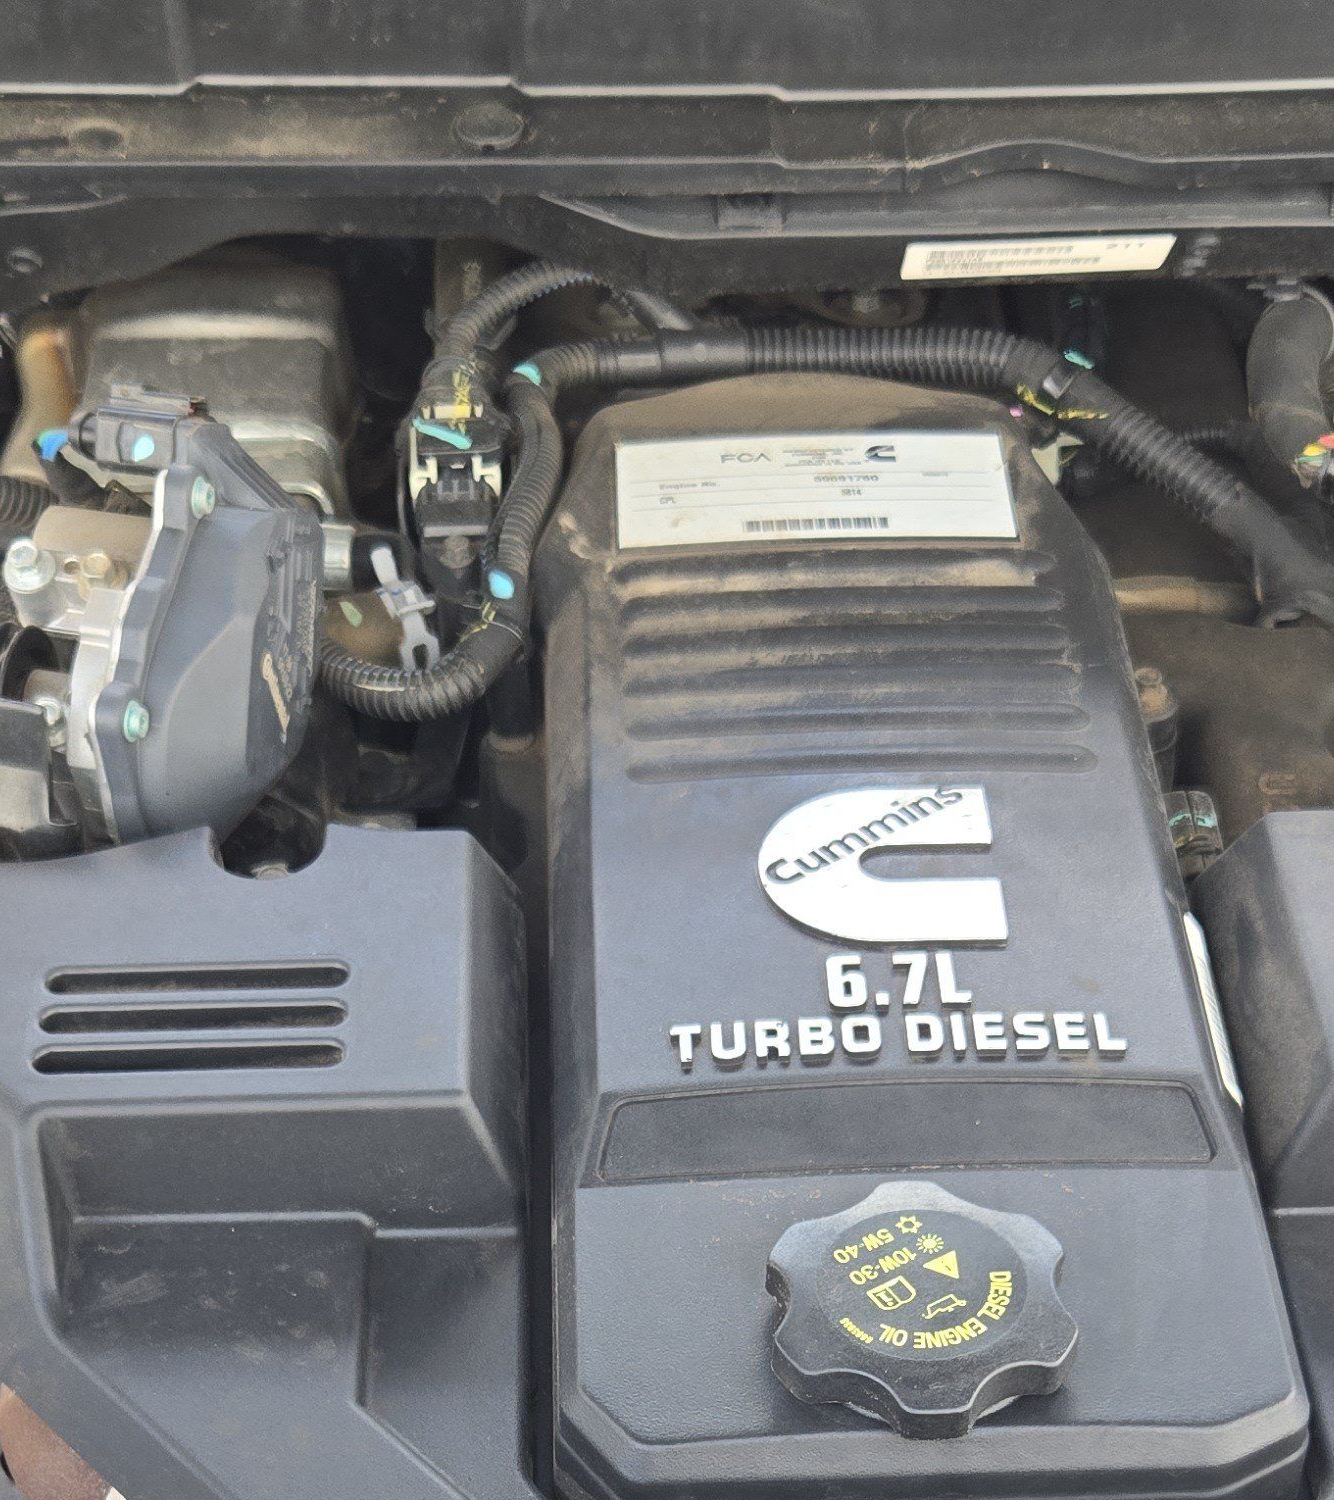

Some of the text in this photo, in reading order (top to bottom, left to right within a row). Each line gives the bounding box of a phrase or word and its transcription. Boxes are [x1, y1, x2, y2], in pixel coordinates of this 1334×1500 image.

[720, 452, 772, 463] FCA
[766, 785, 964, 885] Cummins
[824, 951, 972, 1009] 6.7L
[670, 1012, 1129, 1068] TURBO DIESEL
[833, 1228, 894, 1264] 5W-40
[848, 1247, 917, 1285] 10W-30
[977, 1270, 1013, 1320] DIESEL
[879, 1323, 908, 1347] OIL
[913, 1317, 988, 1348] ENGINE
